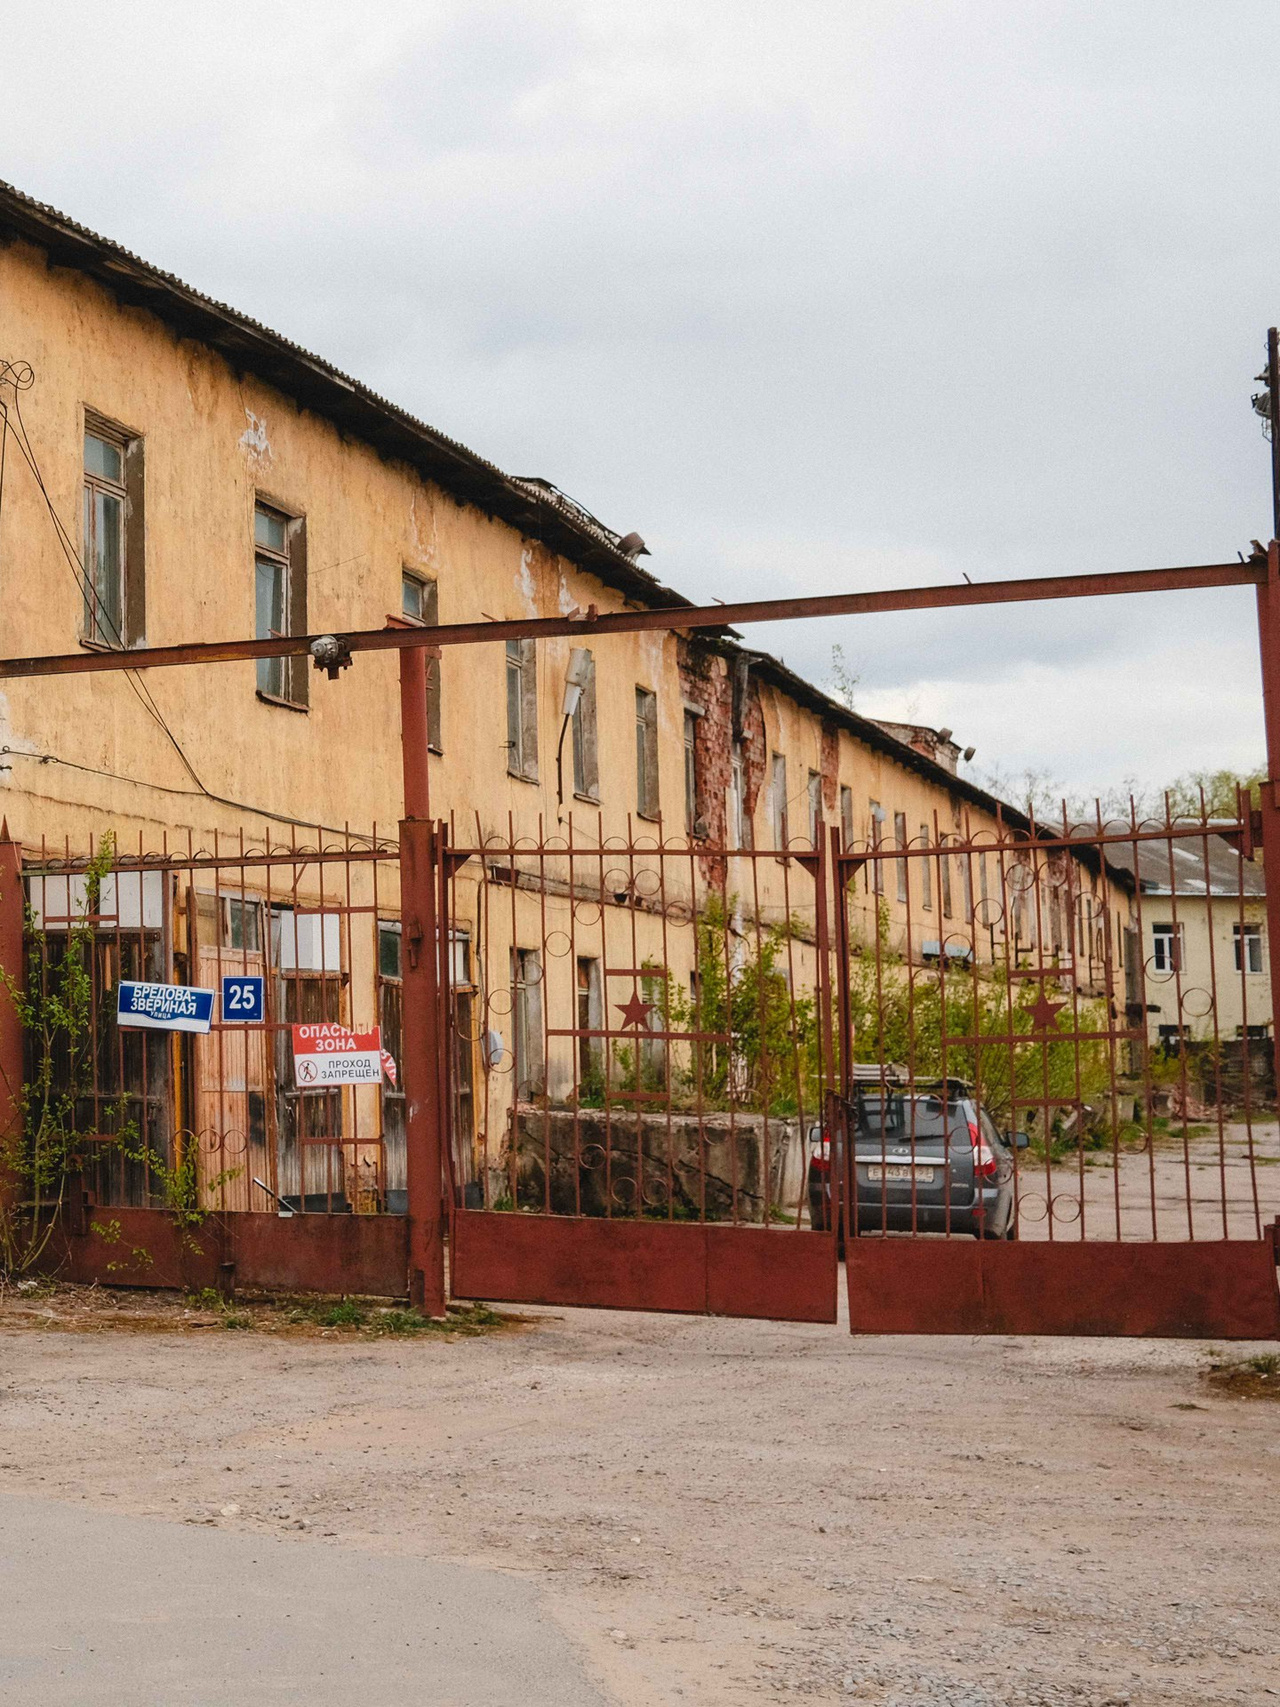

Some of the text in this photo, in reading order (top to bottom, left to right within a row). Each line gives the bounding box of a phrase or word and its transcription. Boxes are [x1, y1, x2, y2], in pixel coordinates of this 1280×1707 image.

[133, 985, 196, 1002] БРЕДОВА-
[229, 985, 255, 1010] 25
[130, 997, 197, 1016] ЗВЕРИНАЯ
[150, 1011, 172, 1019] УЛИЦА
[299, 1024, 372, 1038] ОПАСН
[315, 1038, 357, 1051] ЗОНА
[328, 1059, 371, 1069] ПРОХОД
[321, 1069, 380, 1079] ЗАПРЕЩЕН
